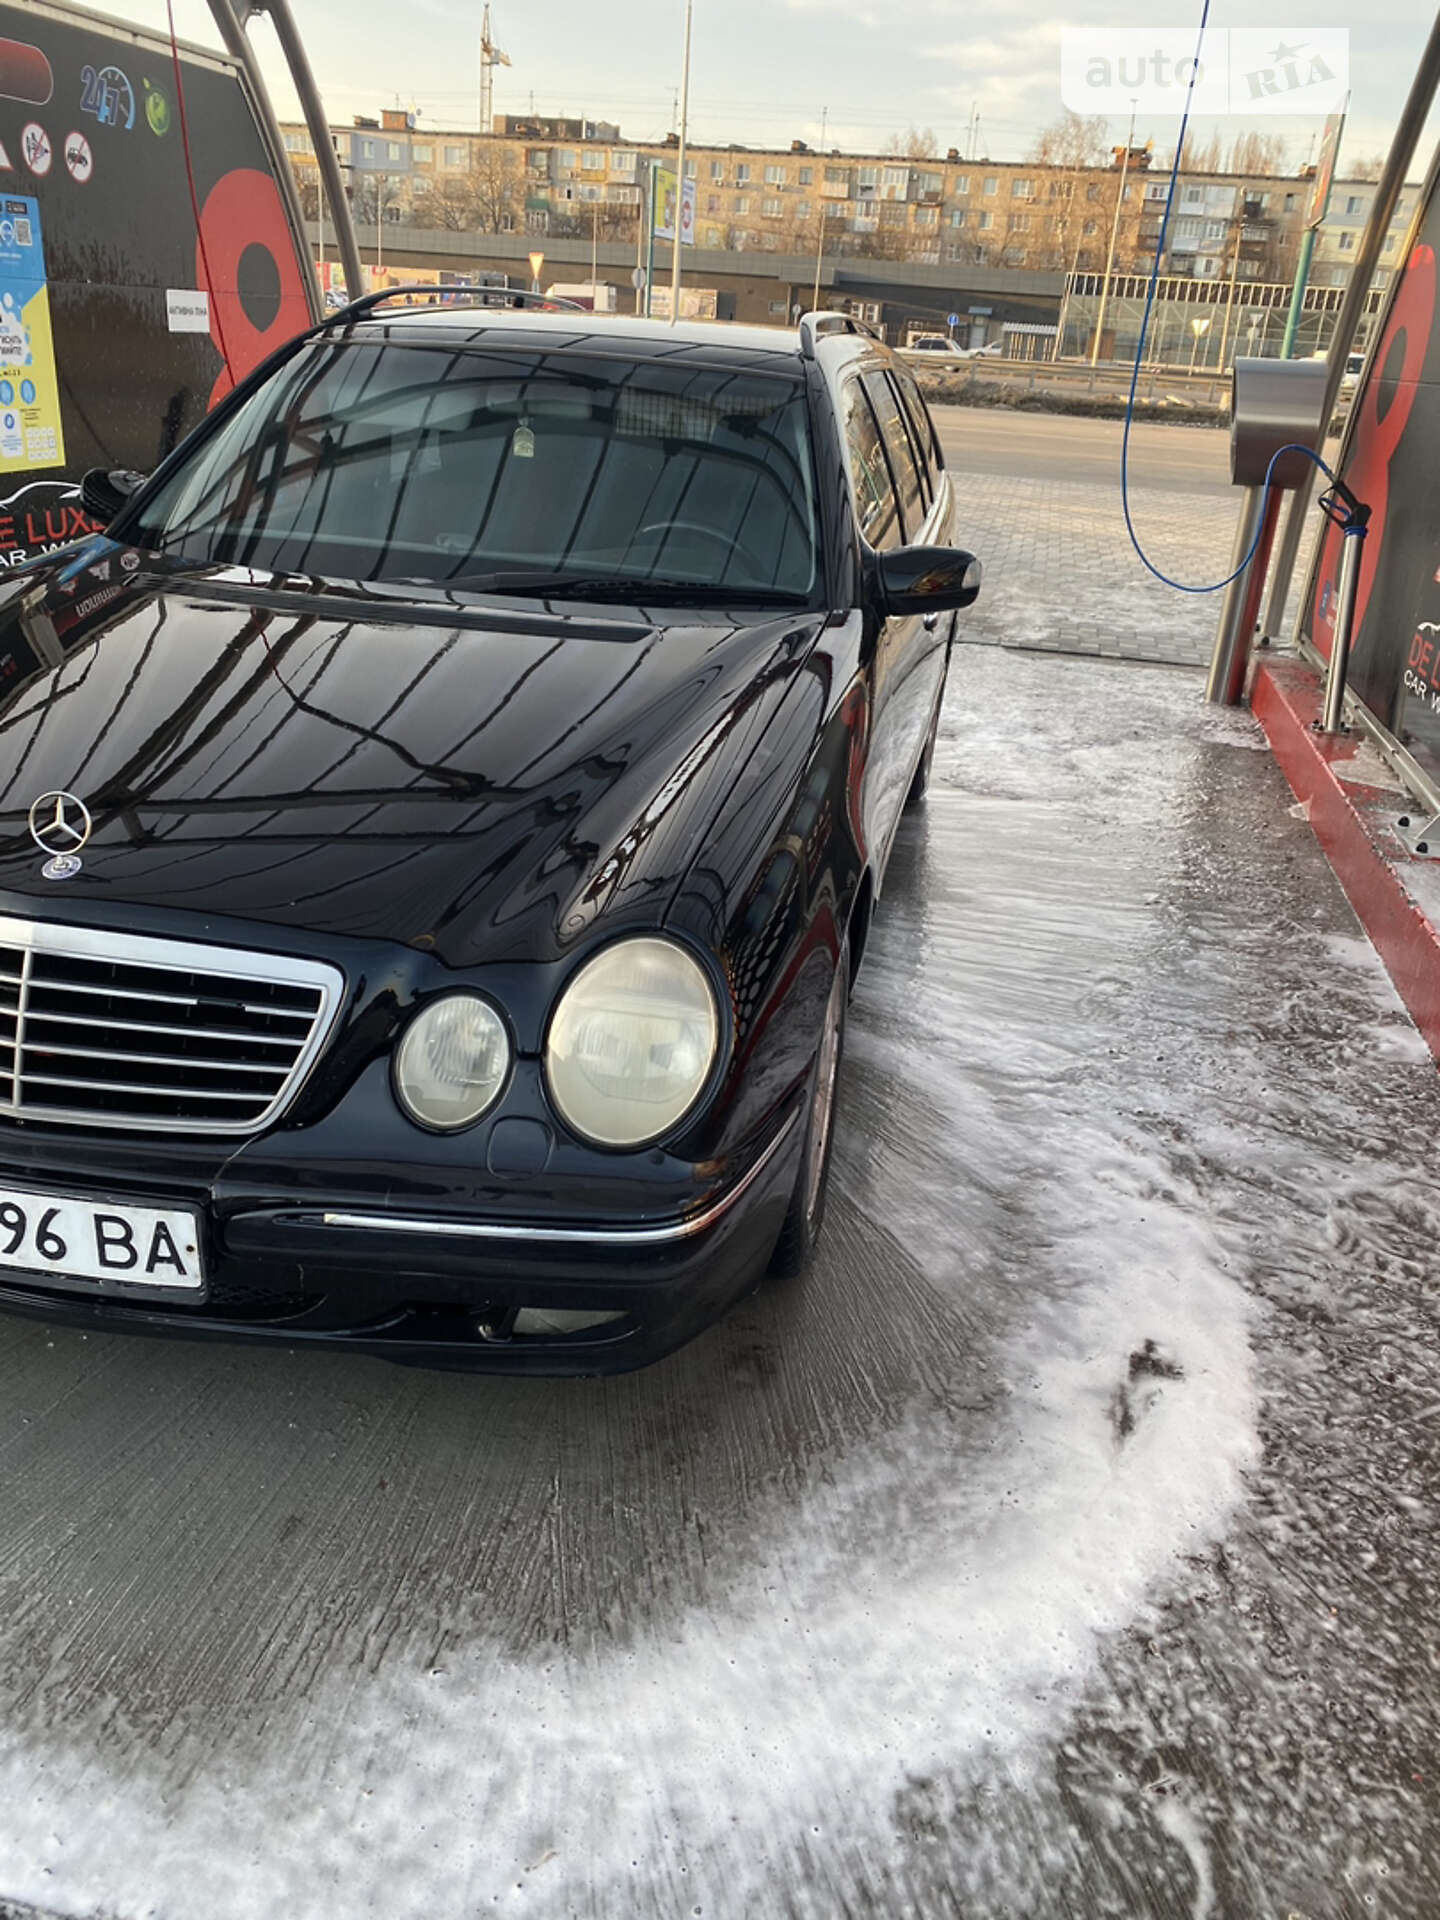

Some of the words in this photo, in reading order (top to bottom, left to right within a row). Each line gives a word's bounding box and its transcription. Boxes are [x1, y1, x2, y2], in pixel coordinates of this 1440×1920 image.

[1408, 632, 1434, 678] DE
[1404, 669, 1428, 701] CAR
[0, 1201, 67, 1261] 96
[94, 1213, 188, 1275] BA
